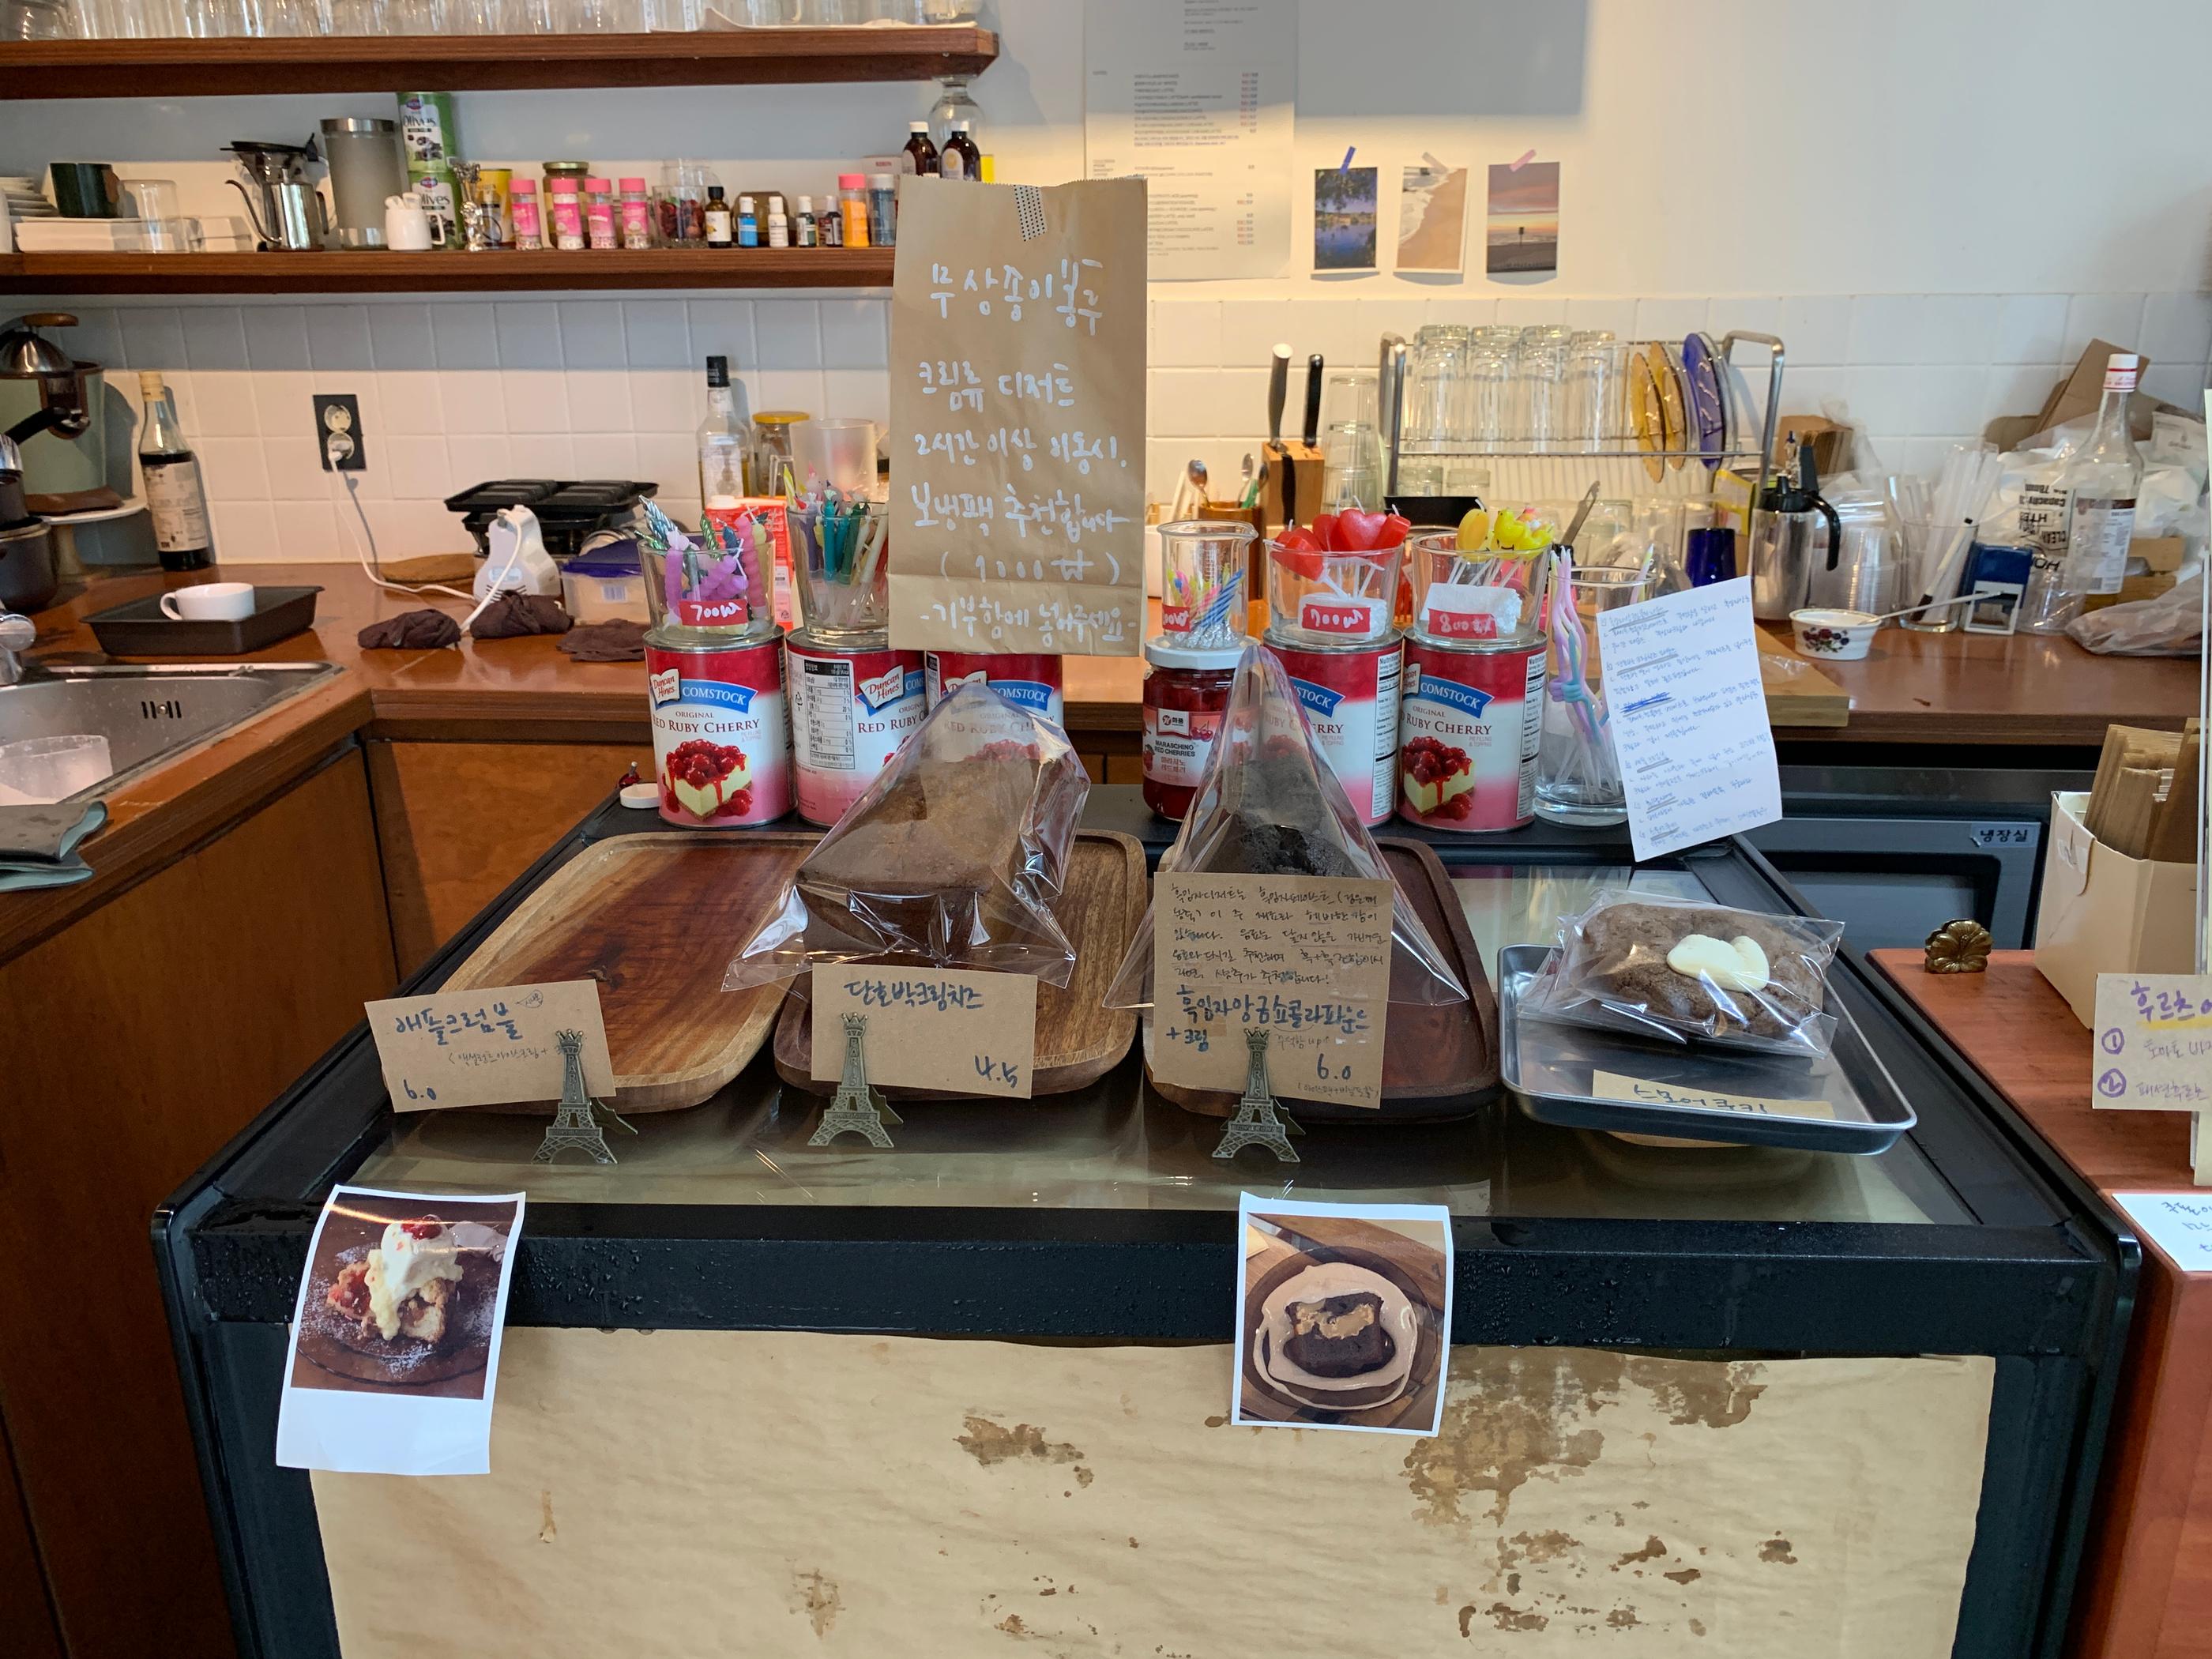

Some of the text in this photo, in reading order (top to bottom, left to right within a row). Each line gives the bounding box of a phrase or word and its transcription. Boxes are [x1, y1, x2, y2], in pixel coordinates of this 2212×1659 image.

[420, 194, 450, 205] lives
[918, 360, 1075, 413] 크림류 디저트
[914, 429, 980, 465] 2시간
[987, 427, 1037, 472] 이상
[653, 675, 675, 690] Duncan
[657, 686, 675, 698] Hines
[865, 673, 900, 695] Duncan
[876, 684, 899, 702] Hines
[682, 687, 747, 705] COMSTOCK
[1294, 686, 1333, 709] STOCK
[1420, 682, 1481, 709] COMSTOCK
[1413, 705, 1446, 717] ORIGINAL
[669, 720, 699, 733] RUBY
[704, 719, 760, 733] CHERRY
[858, 715, 917, 734] RED RUBY
[1407, 713, 1492, 735] RUBY CHERRY
[1155, 739, 1194, 750] MARASCHINO
[1164, 748, 1196, 757] CHERRIES
[1980, 829, 2029, 843] 냉장실
[1210, 909, 1222, 919] 이
[1240, 928, 1272, 940] 음료는
[1281, 928, 1308, 944] 달지
[844, 980, 984, 1011] 단호박크림치즈
[396, 1001, 523, 1046] 애플크럼블
[2143, 1039, 2184, 1059] 토마토
[850, 1038, 859, 1087] PARIS
[974, 1055, 1018, 1089] 4.5
[1317, 1053, 1352, 1080] 6.0
[568, 1054, 577, 1102] PARIS
[1253, 1051, 1262, 1098] PARIS
[403, 1078, 437, 1100] 6.0
